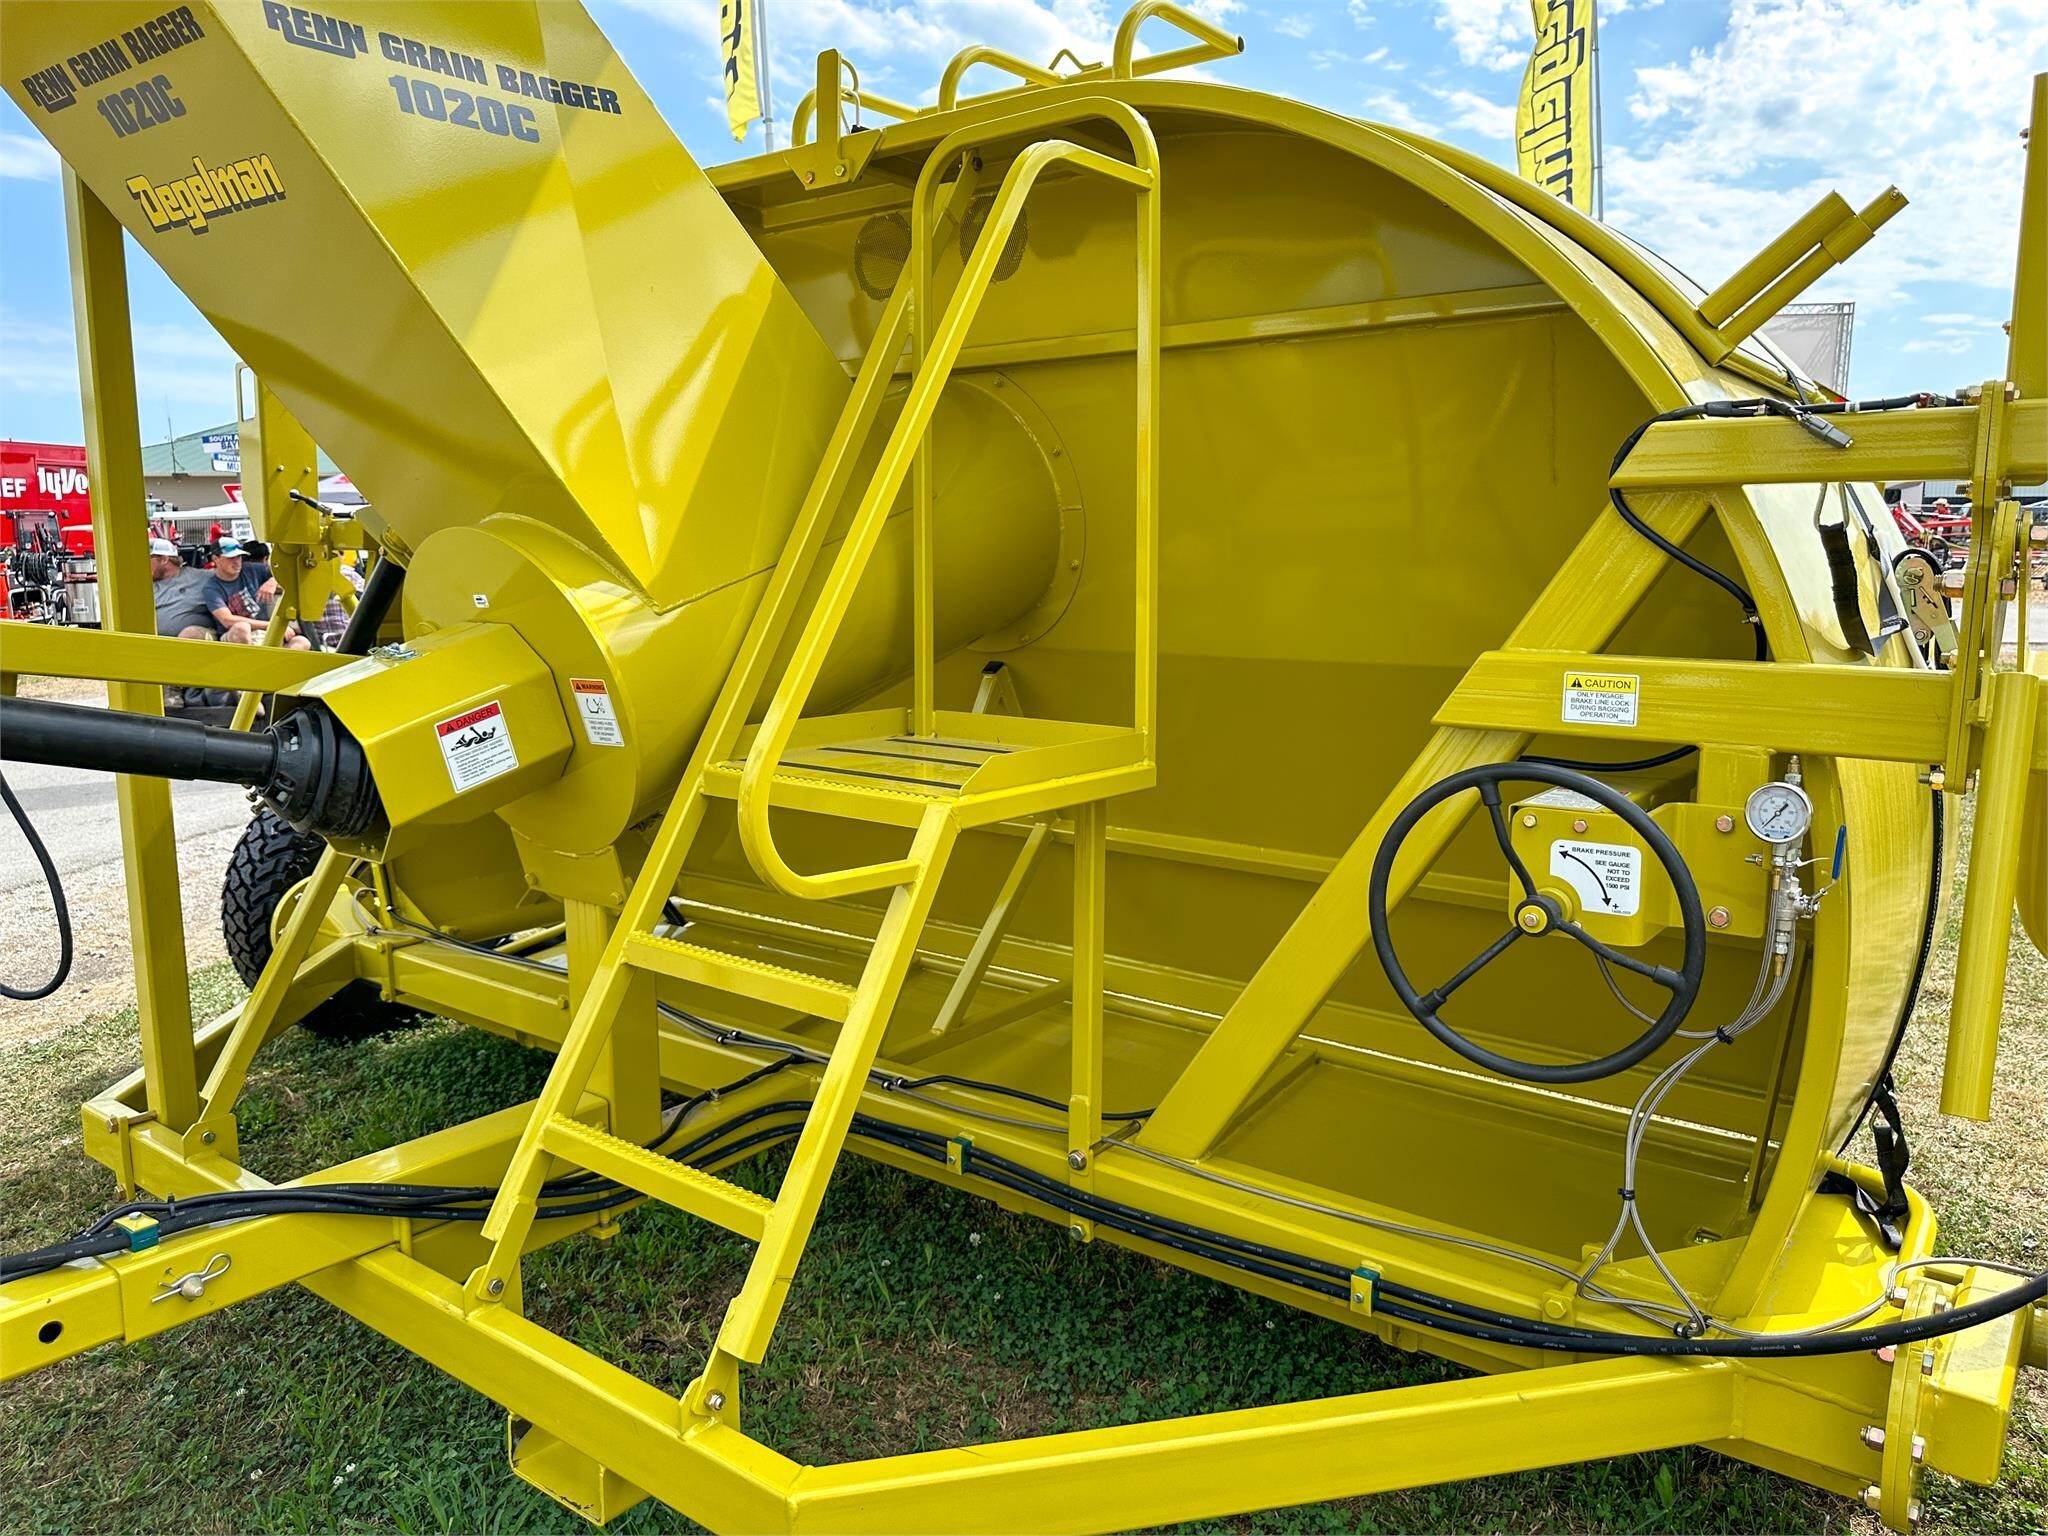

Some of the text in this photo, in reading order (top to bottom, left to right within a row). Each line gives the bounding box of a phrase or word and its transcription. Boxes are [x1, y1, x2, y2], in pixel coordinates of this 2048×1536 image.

[21, 5, 205, 113] RENN GRAIN BAGGER
[262, 0, 622, 115] RENN GRAIN BAGGER
[97, 74, 187, 138] 1020C
[388, 75, 540, 143] 1020C
[126, 153, 286, 235] Degelman
[1584, 679, 1631, 689] CAUTION
[456, 707, 493, 728] DANGER
[1580, 711, 1619, 719] OPERATION
[1598, 705, 1629, 713] BAGGING
[1595, 848, 1631, 858] PRESSURE
